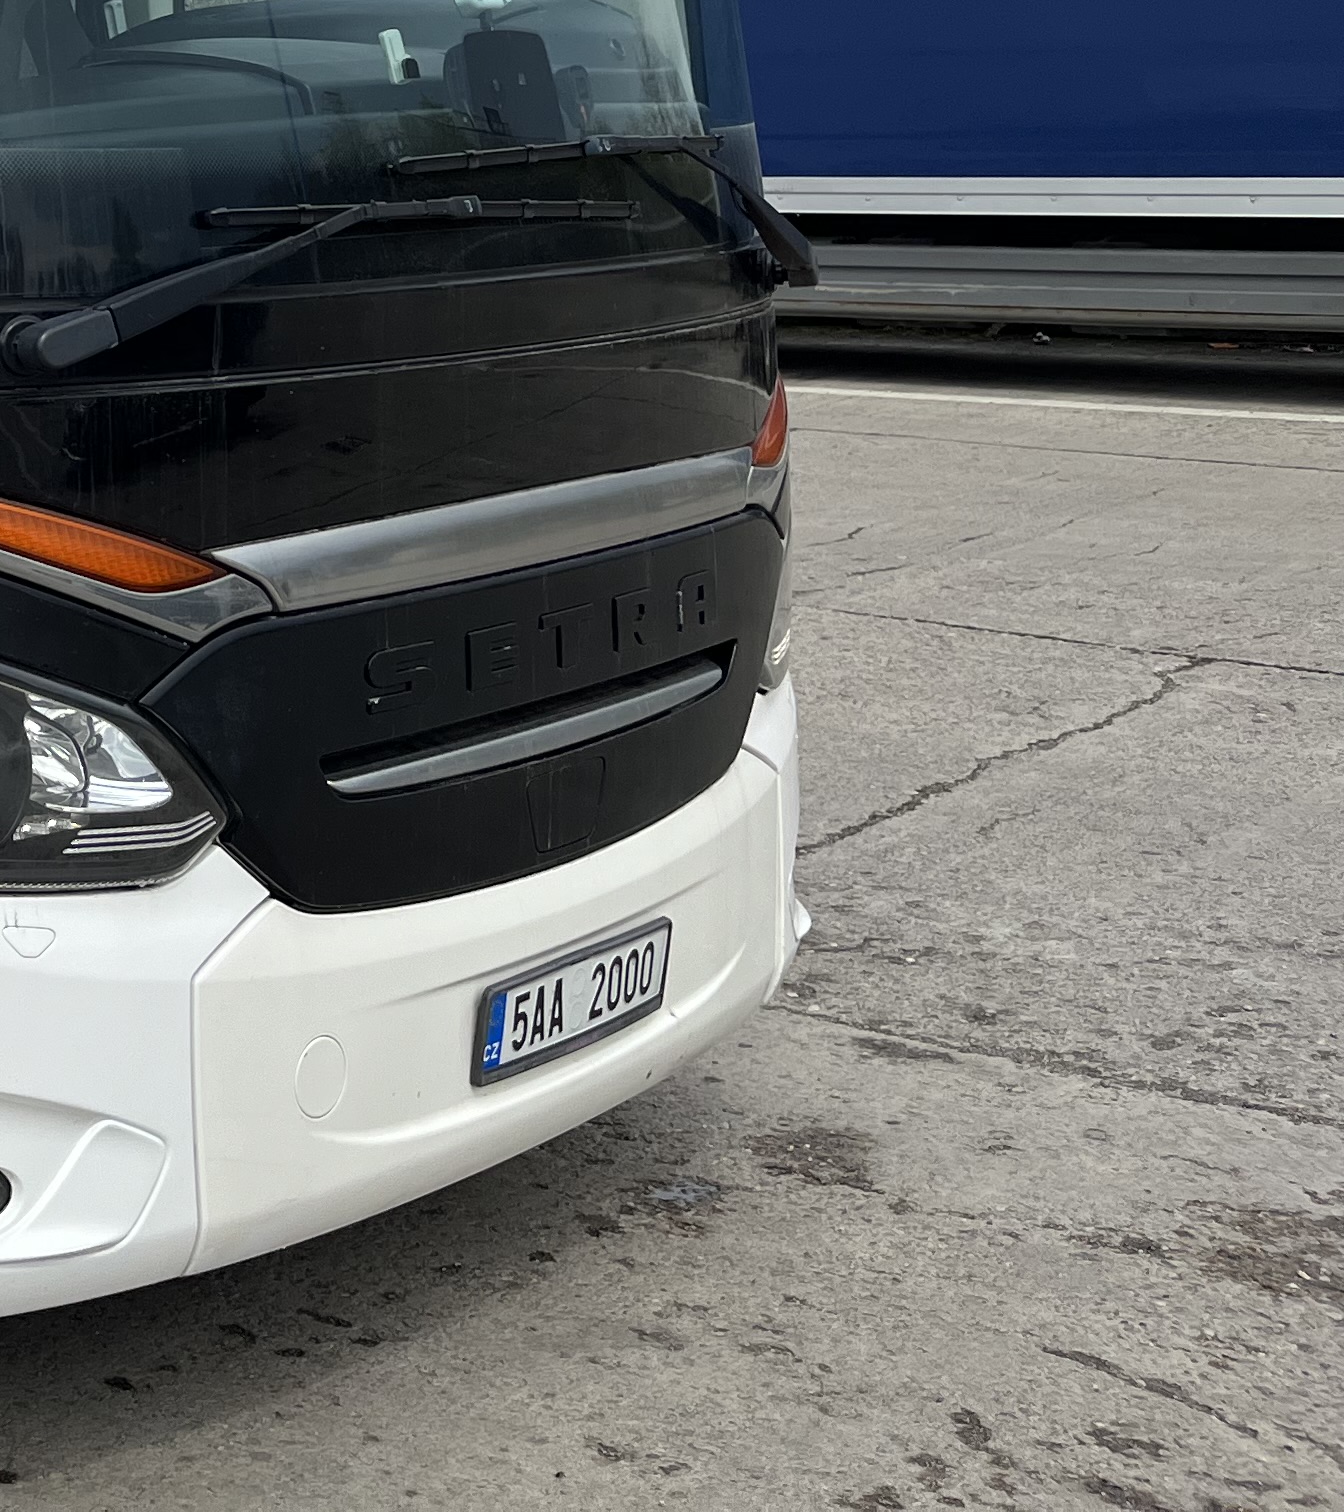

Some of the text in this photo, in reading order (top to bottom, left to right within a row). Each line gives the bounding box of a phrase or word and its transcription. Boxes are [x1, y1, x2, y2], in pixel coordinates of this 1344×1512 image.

[363, 568, 713, 716] SETRA
[482, 1041, 499, 1063] CZ
[512, 941, 655, 1052] 5AA 2000
